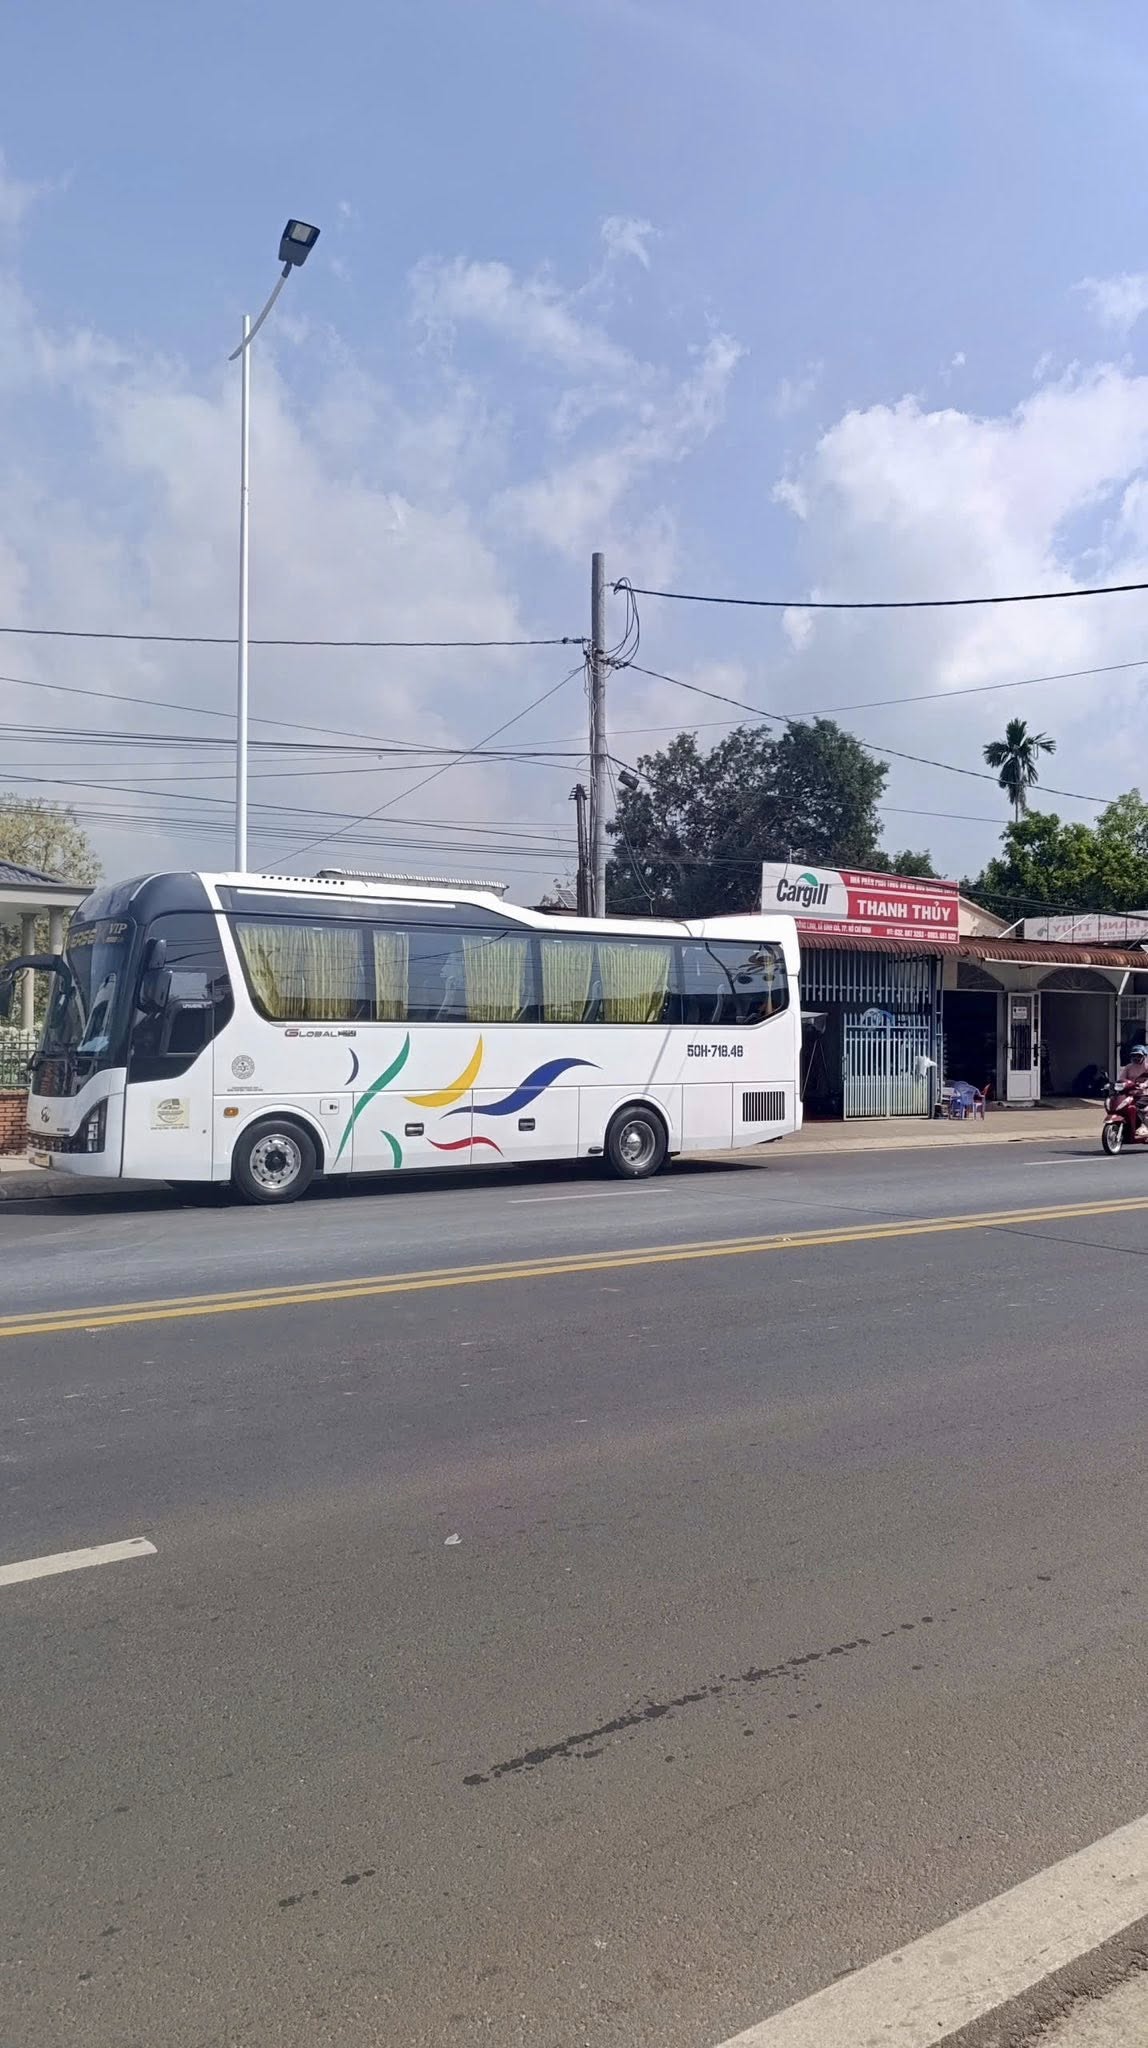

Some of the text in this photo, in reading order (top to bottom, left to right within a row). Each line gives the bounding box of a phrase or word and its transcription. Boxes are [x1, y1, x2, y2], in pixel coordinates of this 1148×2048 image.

[776, 878, 829, 908] Cargill
[857, 899, 951, 922] THANH THỦY
